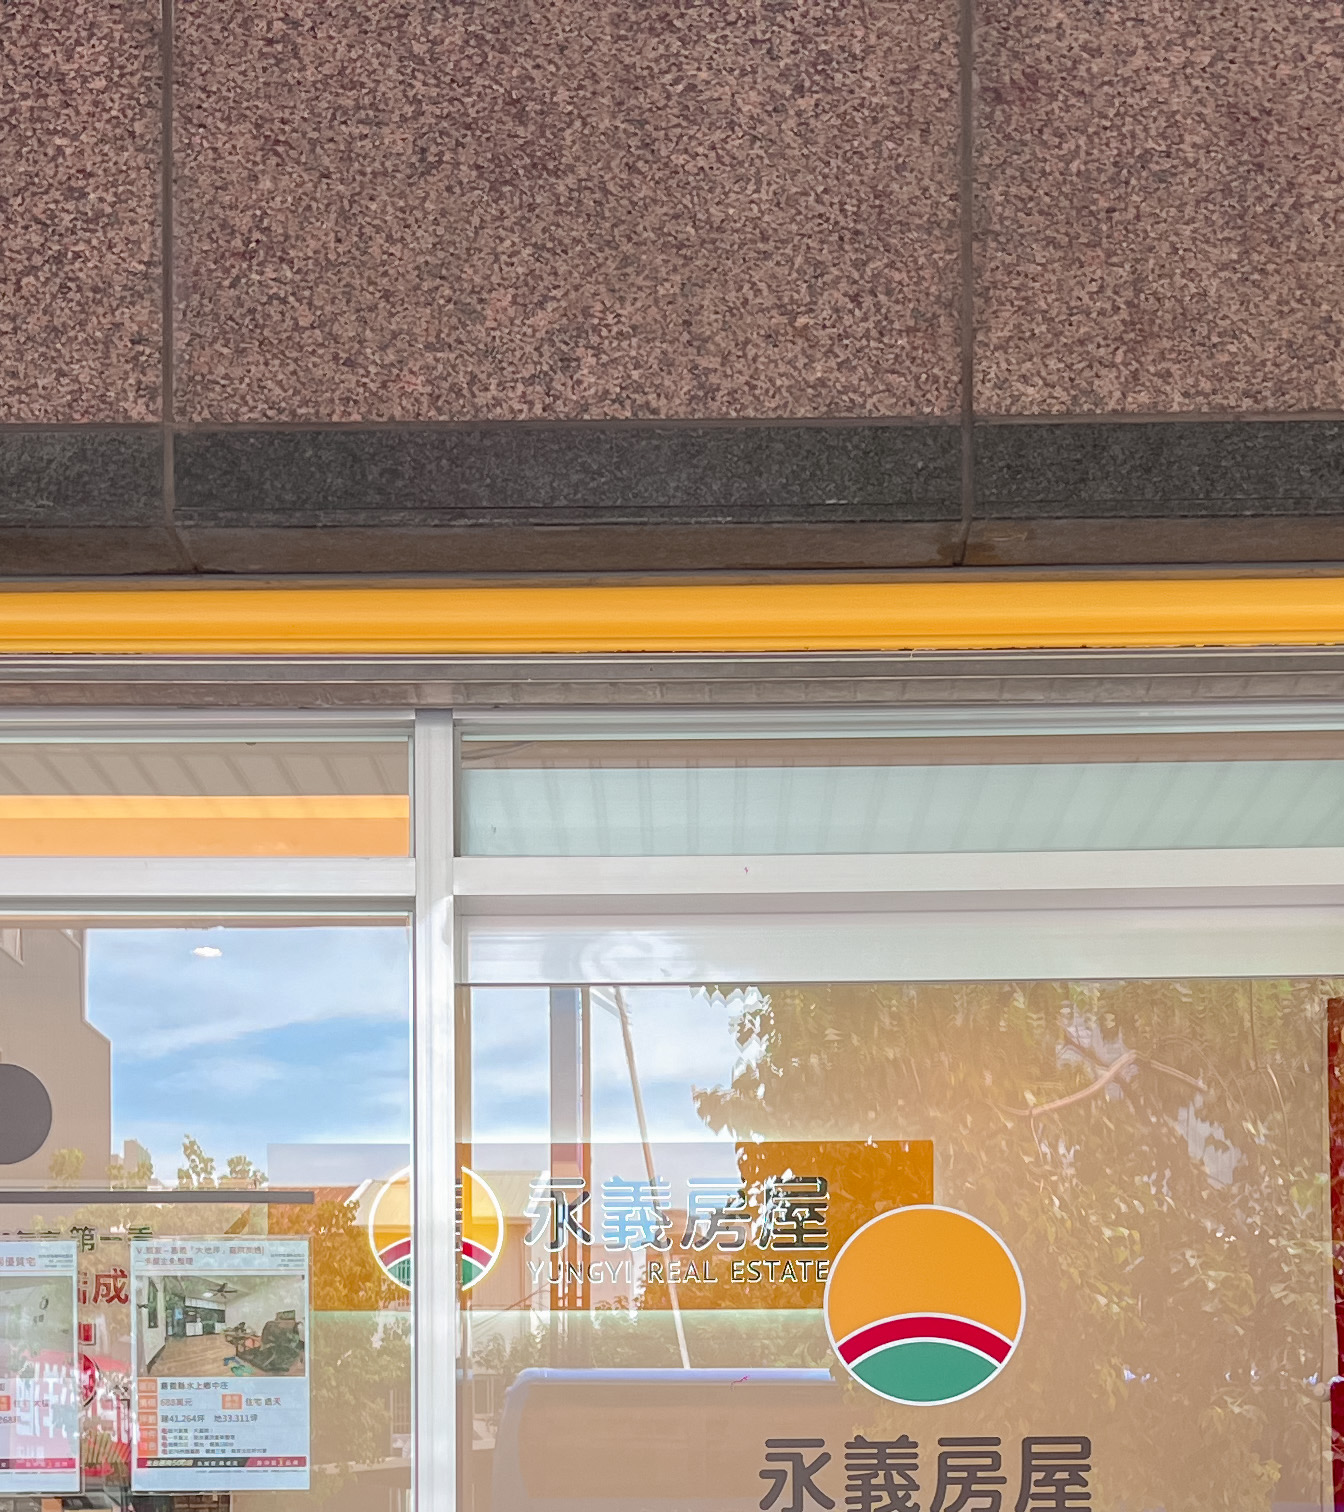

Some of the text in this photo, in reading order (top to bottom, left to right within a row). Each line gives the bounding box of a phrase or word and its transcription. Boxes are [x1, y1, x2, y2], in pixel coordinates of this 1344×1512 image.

[523, 1175, 832, 1252] 永義房屋
[528, 1259, 831, 1285] YUNGYI REAL ESTATE
